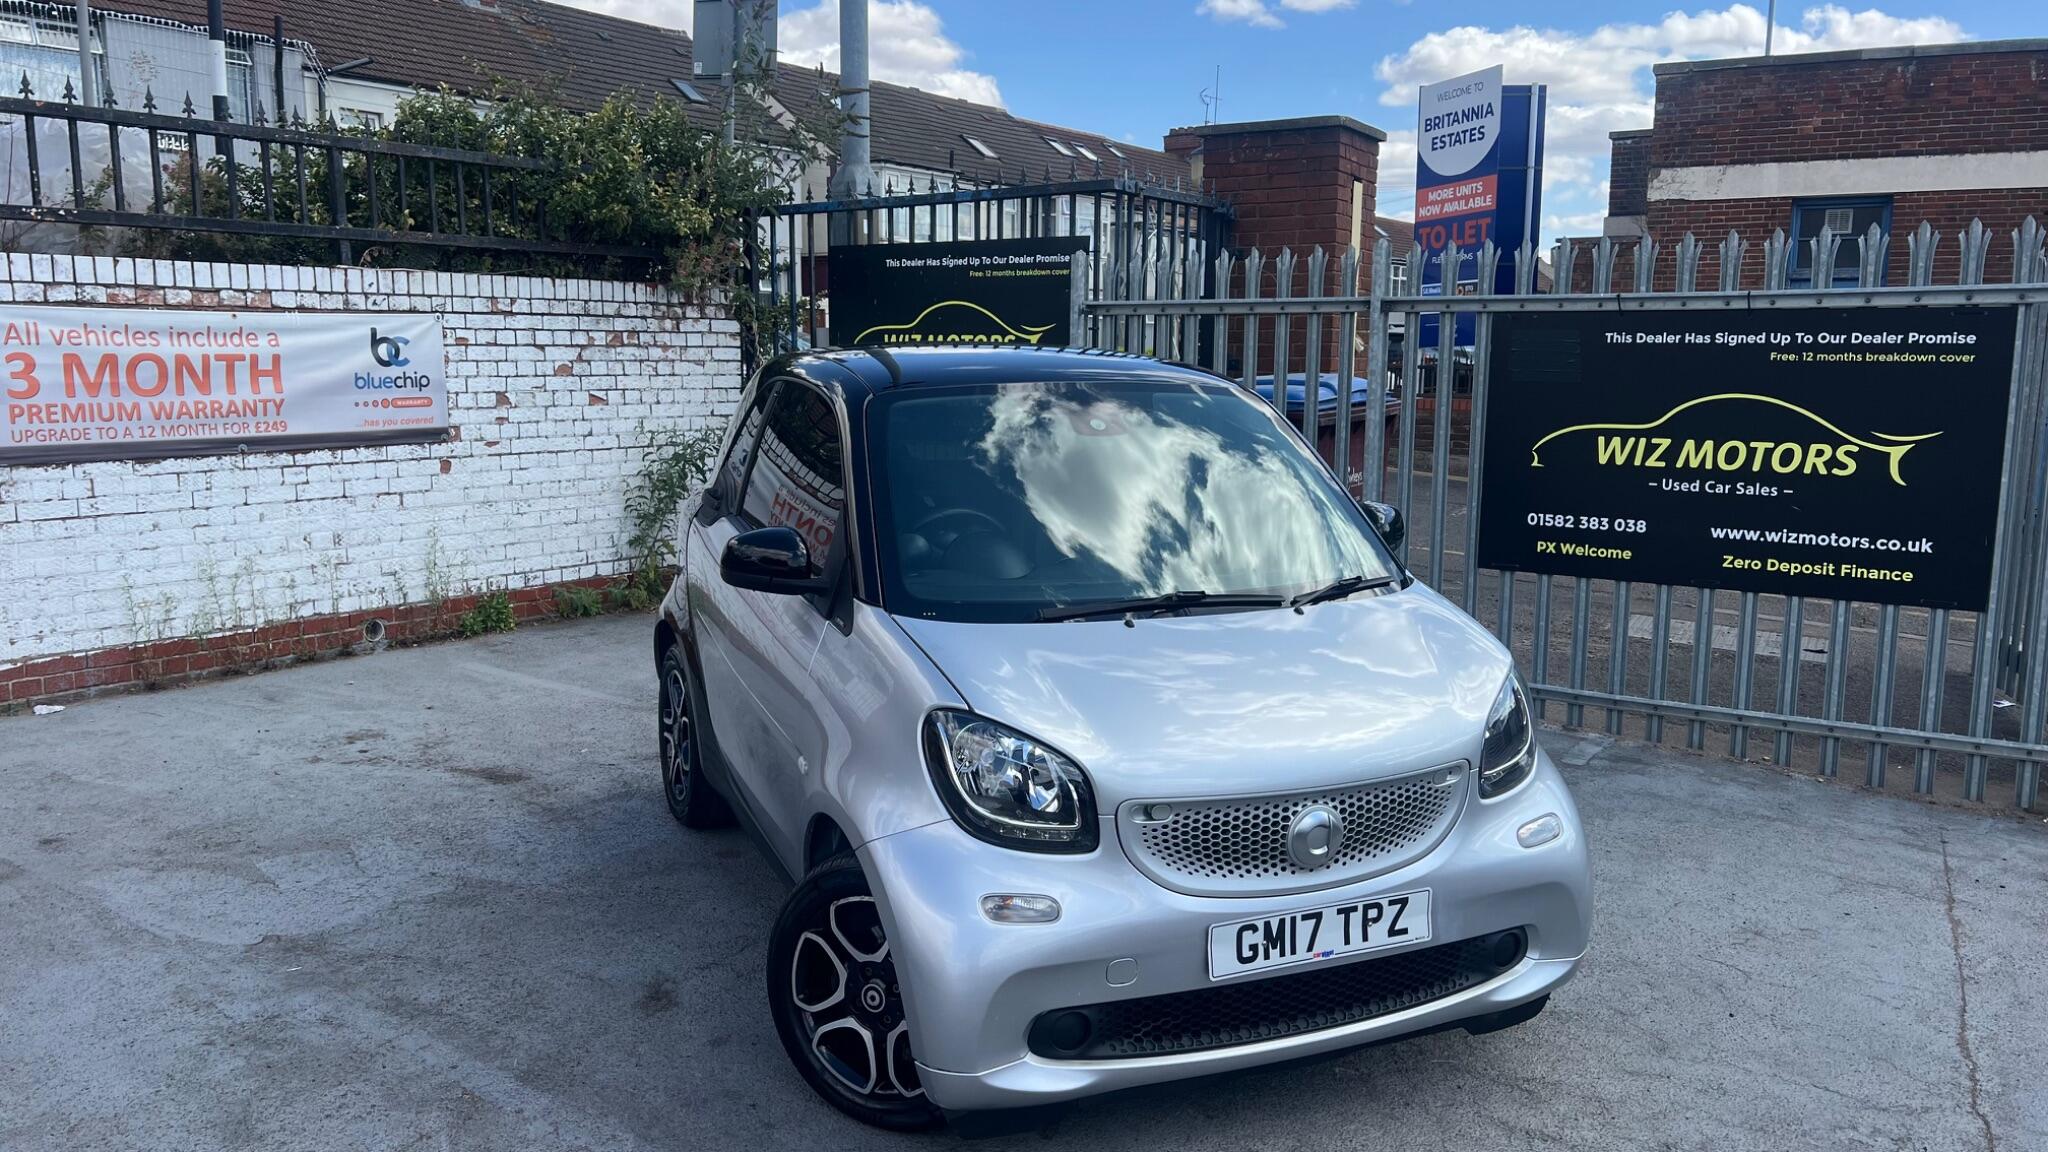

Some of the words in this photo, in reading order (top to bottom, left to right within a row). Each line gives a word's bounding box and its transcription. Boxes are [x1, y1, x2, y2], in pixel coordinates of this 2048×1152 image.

[1437, 85, 1472, 102] WELCOME
[1474, 82, 1484, 92] TO
[1424, 102, 1494, 132] BRITANNIA
[1431, 125, 1485, 151] ESTATES
[1428, 188, 1454, 202] MORE
[1456, 182, 1483, 196] UNITS
[1419, 204, 1441, 217] NOW
[1443, 195, 1492, 213] AVAILABLE
[1418, 224, 1446, 250] TO
[1452, 217, 1491, 246] LET
[886, 259, 900, 267] This
[901, 258, 925, 267] Dealer
[927, 258, 940, 266] Has
[942, 257, 967, 267] Signed
[969, 257, 980, 267] Up
[981, 257, 991, 265] To
[992, 256, 1007, 264] Our
[1009, 255, 1034, 264] Dealer
[1036, 254, 1070, 263] Promise
[4, 321, 40, 346] All
[49, 322, 160, 347] vehicles
[169, 325, 259, 348] include
[266, 332, 280, 347] a
[1605, 332, 1632, 344] This
[1636, 332, 1681, 344] Dealer
[1685, 332, 1711, 344] Has
[1715, 332, 1765, 346] Signed
[1770, 332, 1790, 346] Up
[1795, 332, 1813, 344] To
[1817, 333, 1847, 344] Our
[1851, 332, 1904, 344] Dealer
[1908, 332, 1976, 344] Promise
[1770, 352, 1799, 361] Free:
[1802, 352, 1813, 361] 12
[1817, 352, 1862, 361] months
[1866, 352, 1936, 362] breakdown
[1939, 353, 1975, 362] cover
[5, 351, 41, 399] 3
[62, 352, 284, 397] MONTH
[354, 371, 430, 392] bluechip
[8, 401, 142, 424] PREMIUM
[148, 399, 285, 421] WARRANTY
[382, 418, 398, 427] you
[400, 416, 434, 426] covered
[11, 426, 91, 443] UPGRADE
[96, 426, 118, 441] TO
[123, 426, 134, 439] A
[139, 425, 156, 438] 12
[161, 423, 218, 437] MONTH
[223, 422, 251, 435] FOR
[254, 420, 288, 433] £249
[1597, 436, 1671, 467] WIZ
[1675, 439, 1860, 477] MOTORS
[1662, 478, 1700, 493] Used
[1705, 481, 1731, 494] Car
[1736, 481, 1778, 497] Sales
[1527, 512, 1574, 528] 01582
[1578, 515, 1609, 530] 383
[1614, 518, 1647, 533] 038
[1537, 540, 1556, 554] PX
[1560, 542, 1632, 560] Welcome
[1710, 526, 1934, 554] www.wizmotors.co.uk
[1722, 555, 1762, 570] Zero
[1766, 558, 1835, 576] Deposit
[1840, 564, 1914, 582] Finance
[1236, 911, 1324, 965] GM17
[1336, 896, 1410, 946] TPZ
